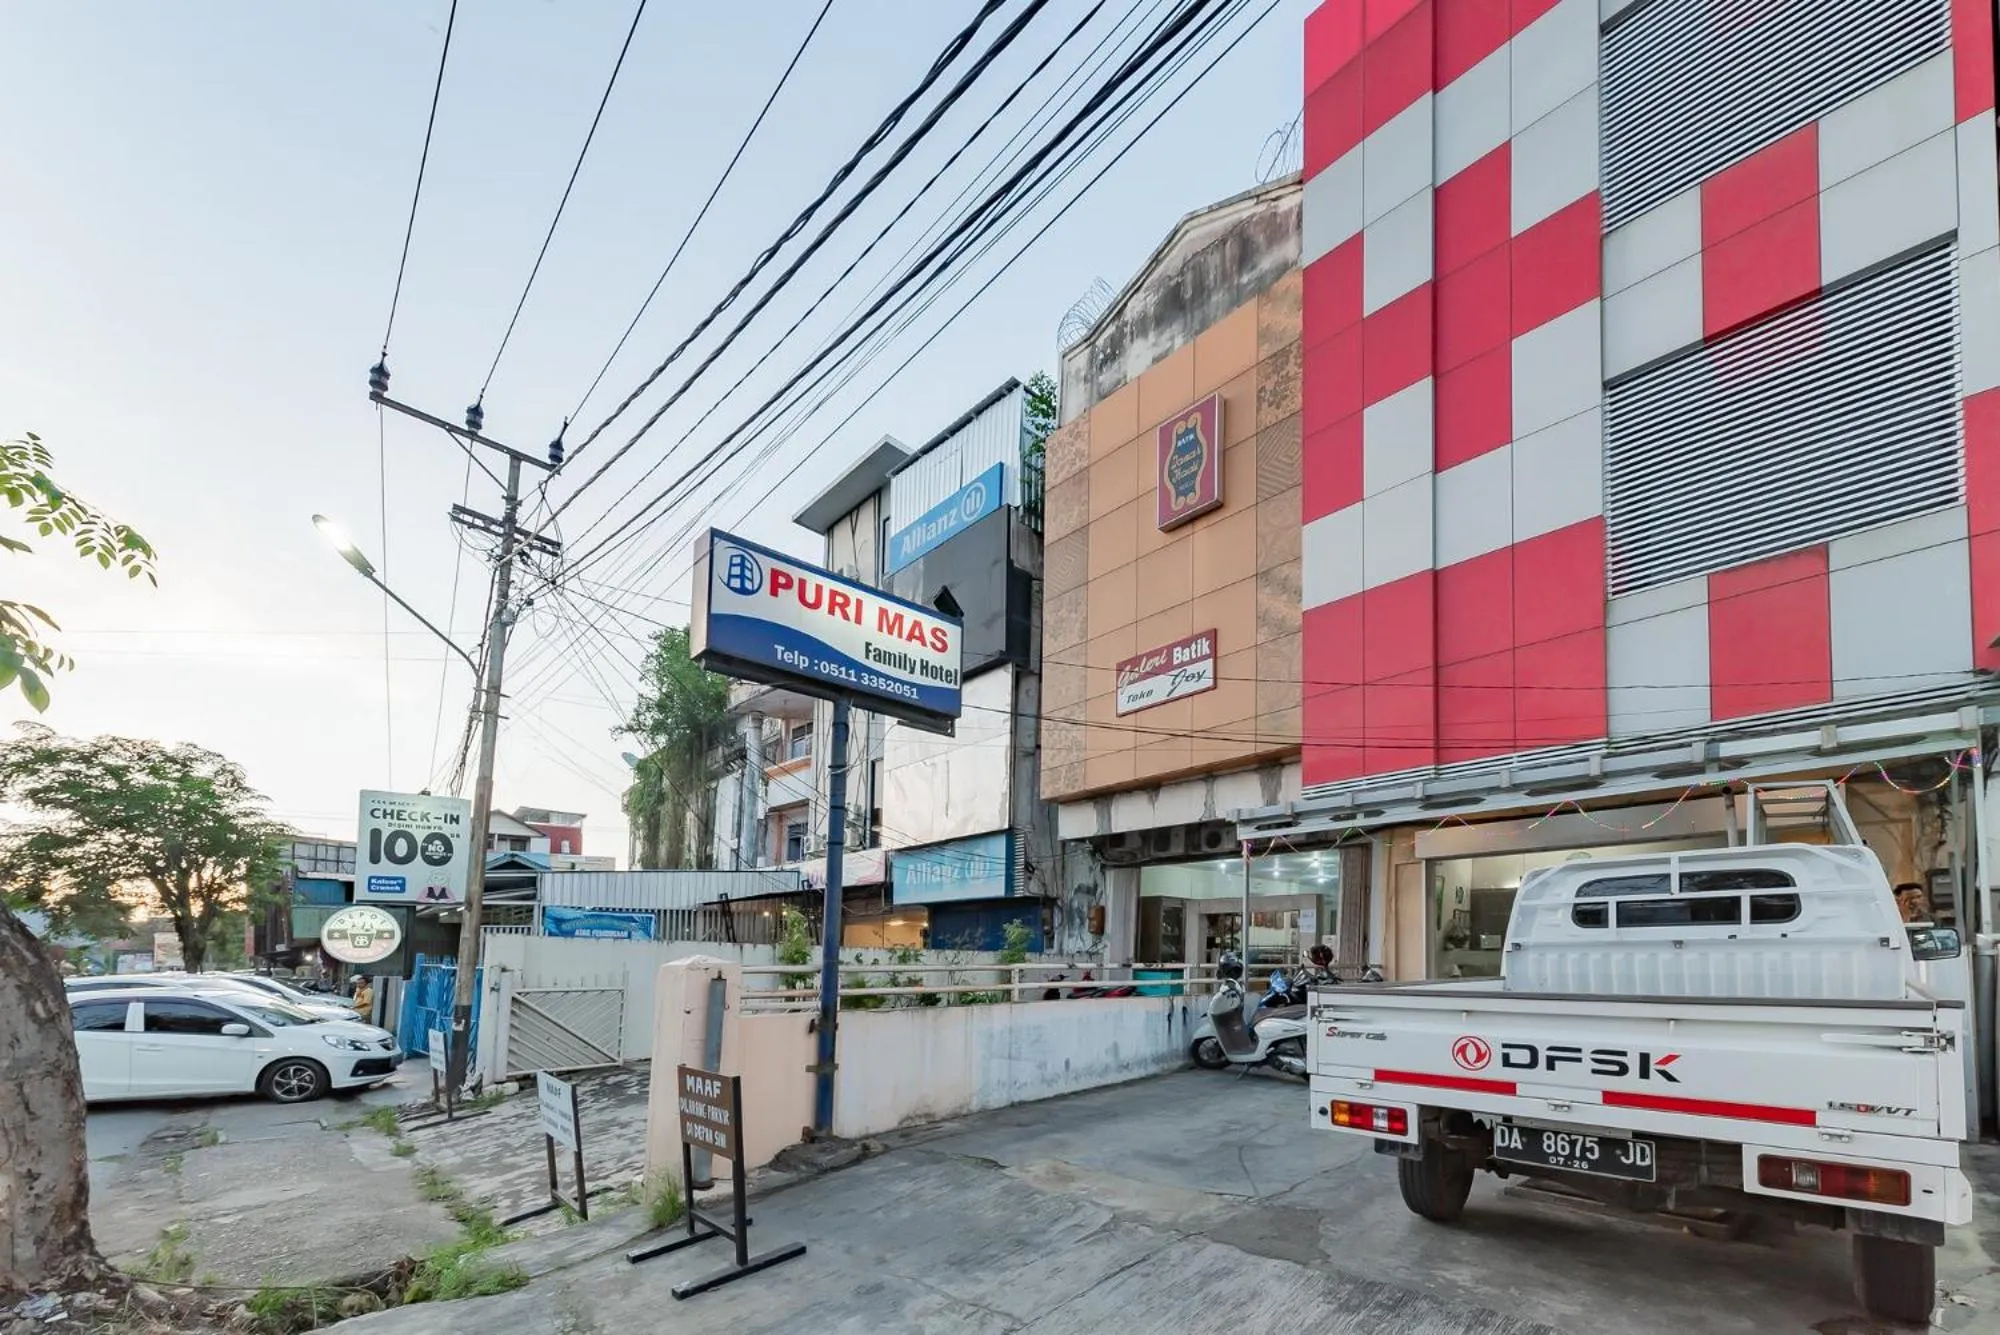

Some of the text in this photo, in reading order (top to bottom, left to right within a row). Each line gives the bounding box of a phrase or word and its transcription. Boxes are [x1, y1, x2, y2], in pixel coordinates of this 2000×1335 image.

[901, 507, 958, 556] Allianz
[769, 568, 949, 653] PURI MAS
[864, 641, 959, 686] Family Hotel
[1173, 637, 1210, 665] Batik
[774, 644, 810, 668] Telp
[861, 672, 919, 699] 3352051
[1167, 668, 1206, 697] Joy
[370, 807, 460, 825] CHECK-IN
[369, 828, 454, 867] 100
[906, 861, 961, 886] Allianz
[1501, 1042, 1682, 1083] DFSK
[686, 1074, 722, 1098] MAAF
[1496, 1125, 1651, 1166] DA 8675 JD
